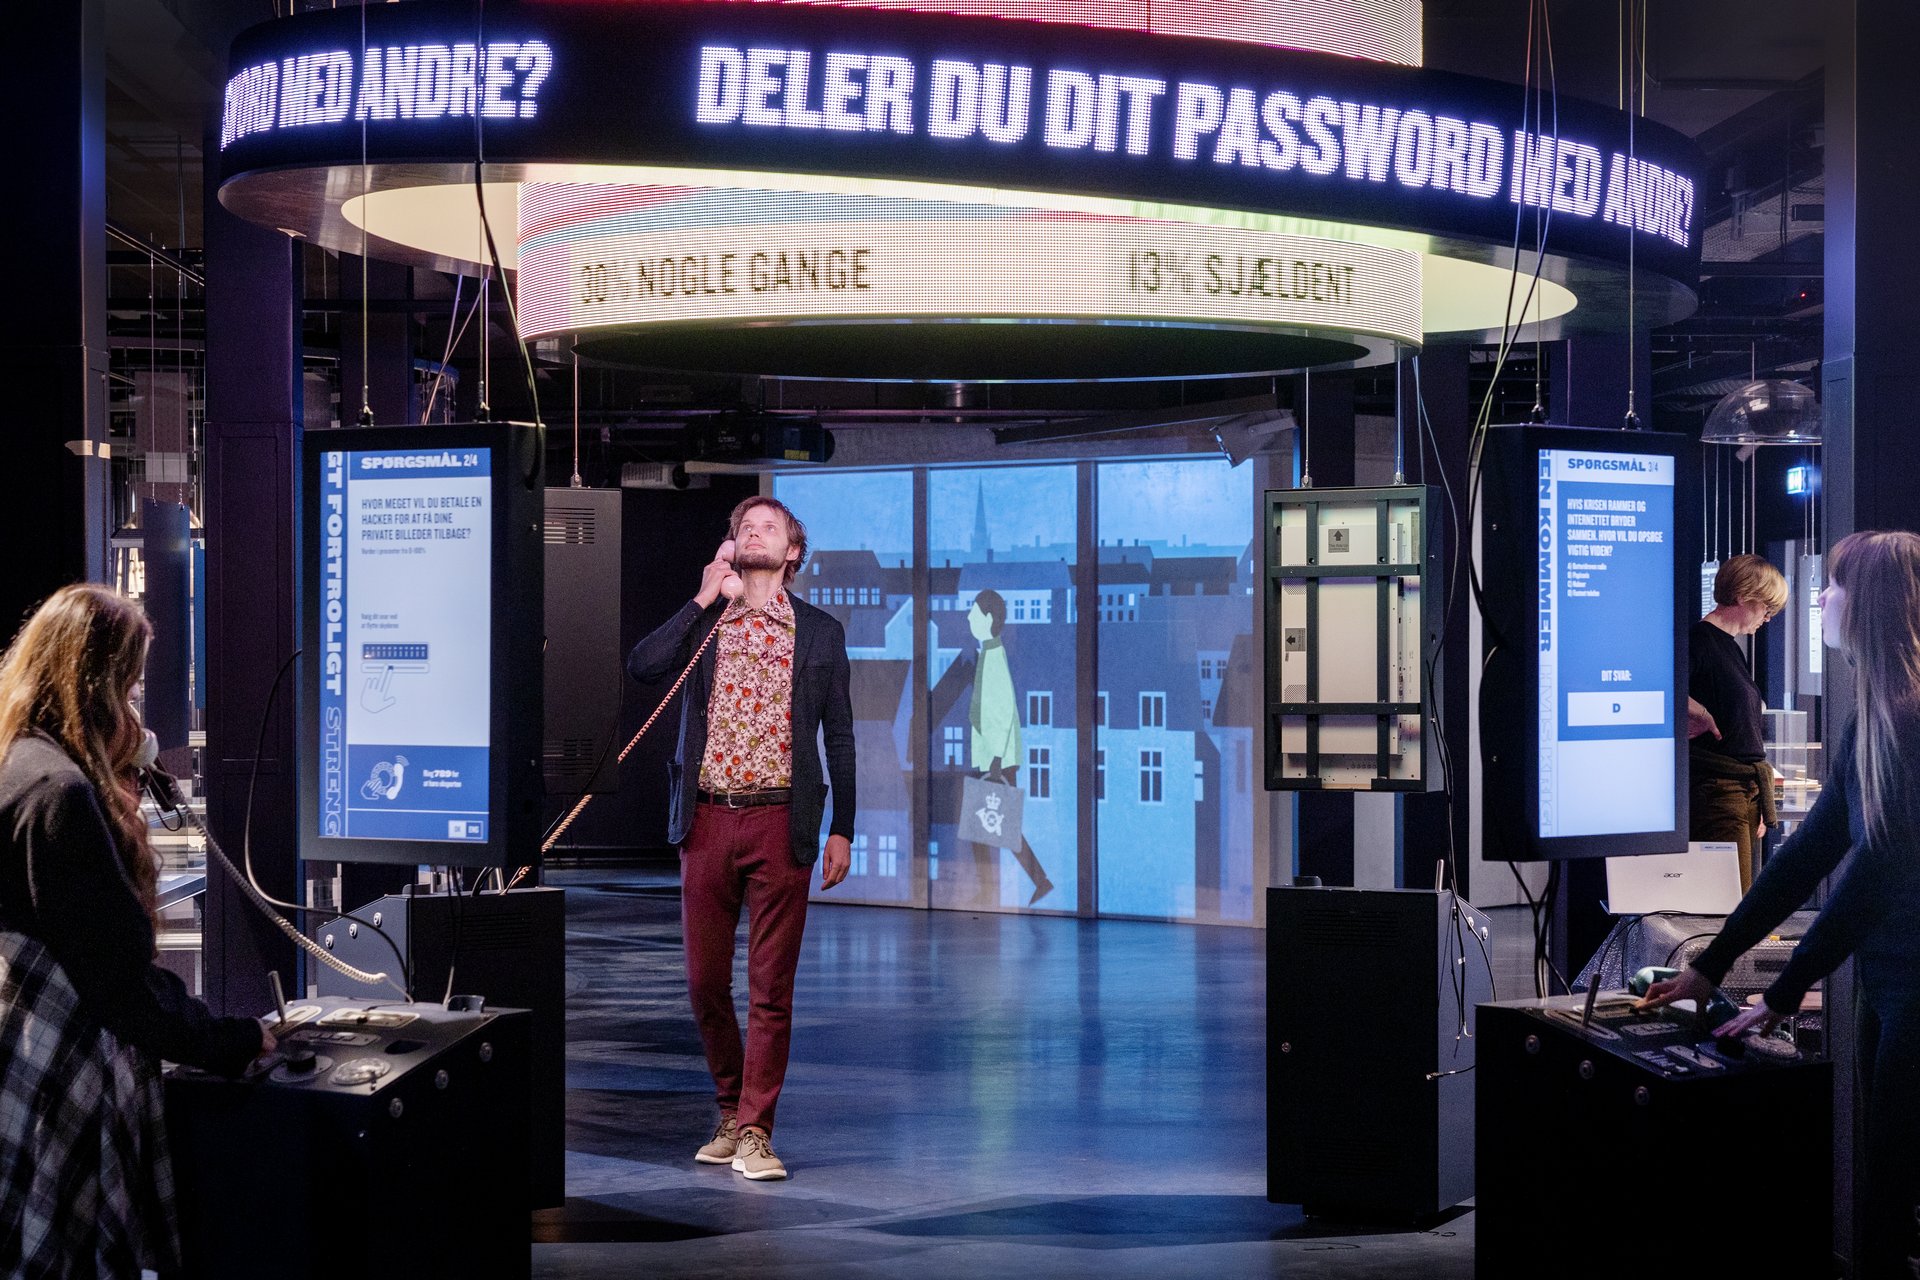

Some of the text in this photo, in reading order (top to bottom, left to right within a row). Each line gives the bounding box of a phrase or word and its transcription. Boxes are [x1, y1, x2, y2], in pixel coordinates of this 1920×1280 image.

[279, 51, 353, 127] MED
[355, 40, 553, 120] ANDRE?
[696, 46, 1694, 247] DELER DU DIT PASSWORD MED ANDRE?
[638, 253, 738, 298] NOGLE
[751, 249, 871, 292] GANGE
[1204, 254, 1355, 304] SJÆLDENT
[361, 452, 478, 469] SPØRGSMÅL 2/4
[1567, 458, 1647, 471] SPØRGSMÅL
[362, 496, 482, 509] HVOR MEGET VIL DU BETALE EN
[1567, 498, 1583, 510] HVIS
[362, 511, 453, 524] HACKER FOR AT FÅ DINE
[1567, 514, 1610, 526] INTERNETTET
[362, 528, 471, 540] PRIVATE BILLEDER TILBAGE?
[1541, 508, 1551, 652] KOMMER
[326, 494, 343, 695] FORTROLIGT
[1601, 670, 1612, 681] DIT
[1612, 703, 1621, 713] D
[325, 706, 342, 837] STRENG
